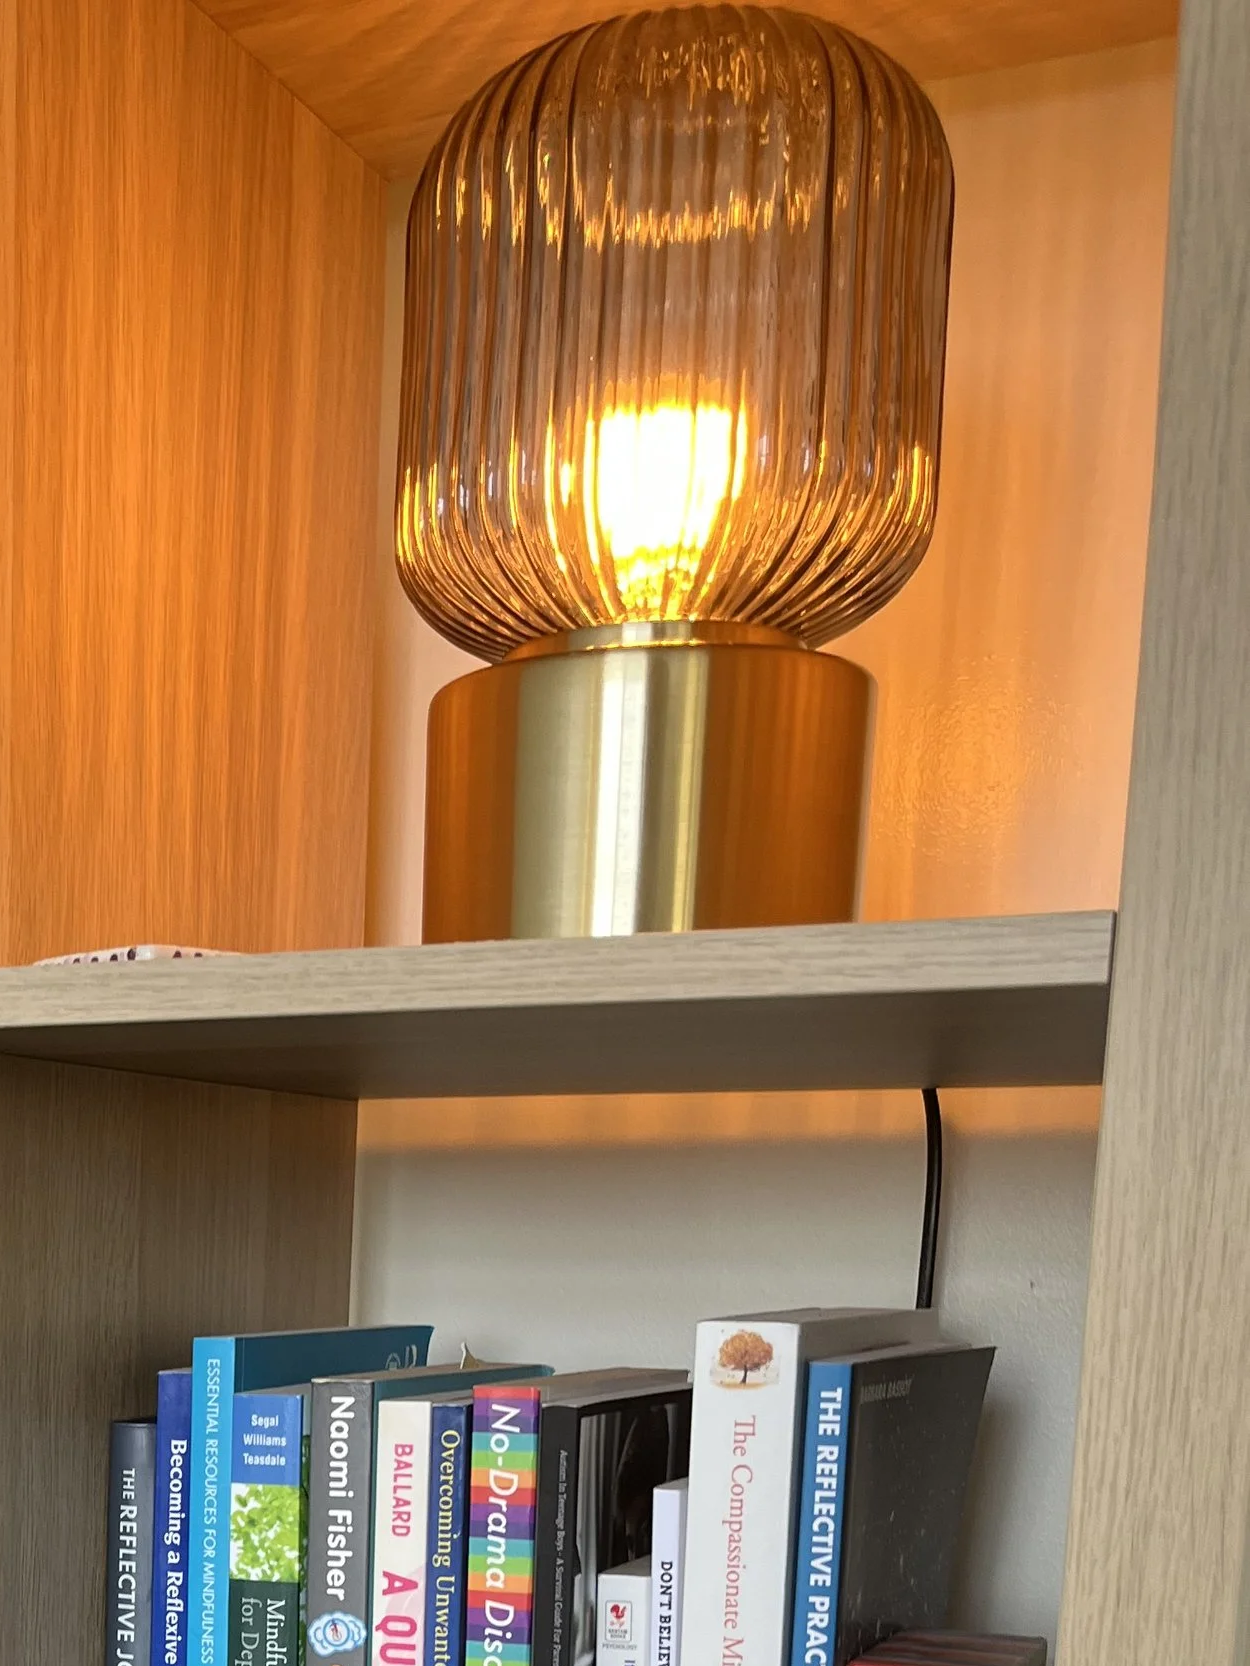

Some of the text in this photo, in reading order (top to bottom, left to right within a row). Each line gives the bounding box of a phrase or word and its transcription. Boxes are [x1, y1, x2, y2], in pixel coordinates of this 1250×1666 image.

[205, 1358, 221, 1436] ESSENTIAL
[251, 1413, 279, 1428] Segal
[732, 1414, 757, 1457] The
[817, 1387, 843, 1437] THE
[243, 1433, 287, 1448] Williams
[243, 1452, 286, 1467] Teasdale
[122, 1467, 136, 1501] THE
[164, 1439, 188, 1546] Becoming
[203, 1438, 221, 1526] RESOURCES
[325, 1396, 356, 1601] Naomi Fisher
[391, 1443, 415, 1538] BALLARD
[432, 1429, 461, 1568] Overcoming
[485, 1403, 523, 1589] No-Drama
[809, 1445, 841, 1588] REFLECTIVE
[117, 1504, 138, 1643] REFLECTIVE
[167, 1552, 181, 1565] a
[201, 1527, 218, 1560] FOR
[721, 1464, 754, 1629] Compassionate
[164, 1571, 184, 1666] Reflexive
[200, 1562, 217, 1665] MINDFULNESS
[241, 1596, 262, 1626] for
[382, 1570, 419, 1596] A
[659, 1560, 673, 1612] DON'T
